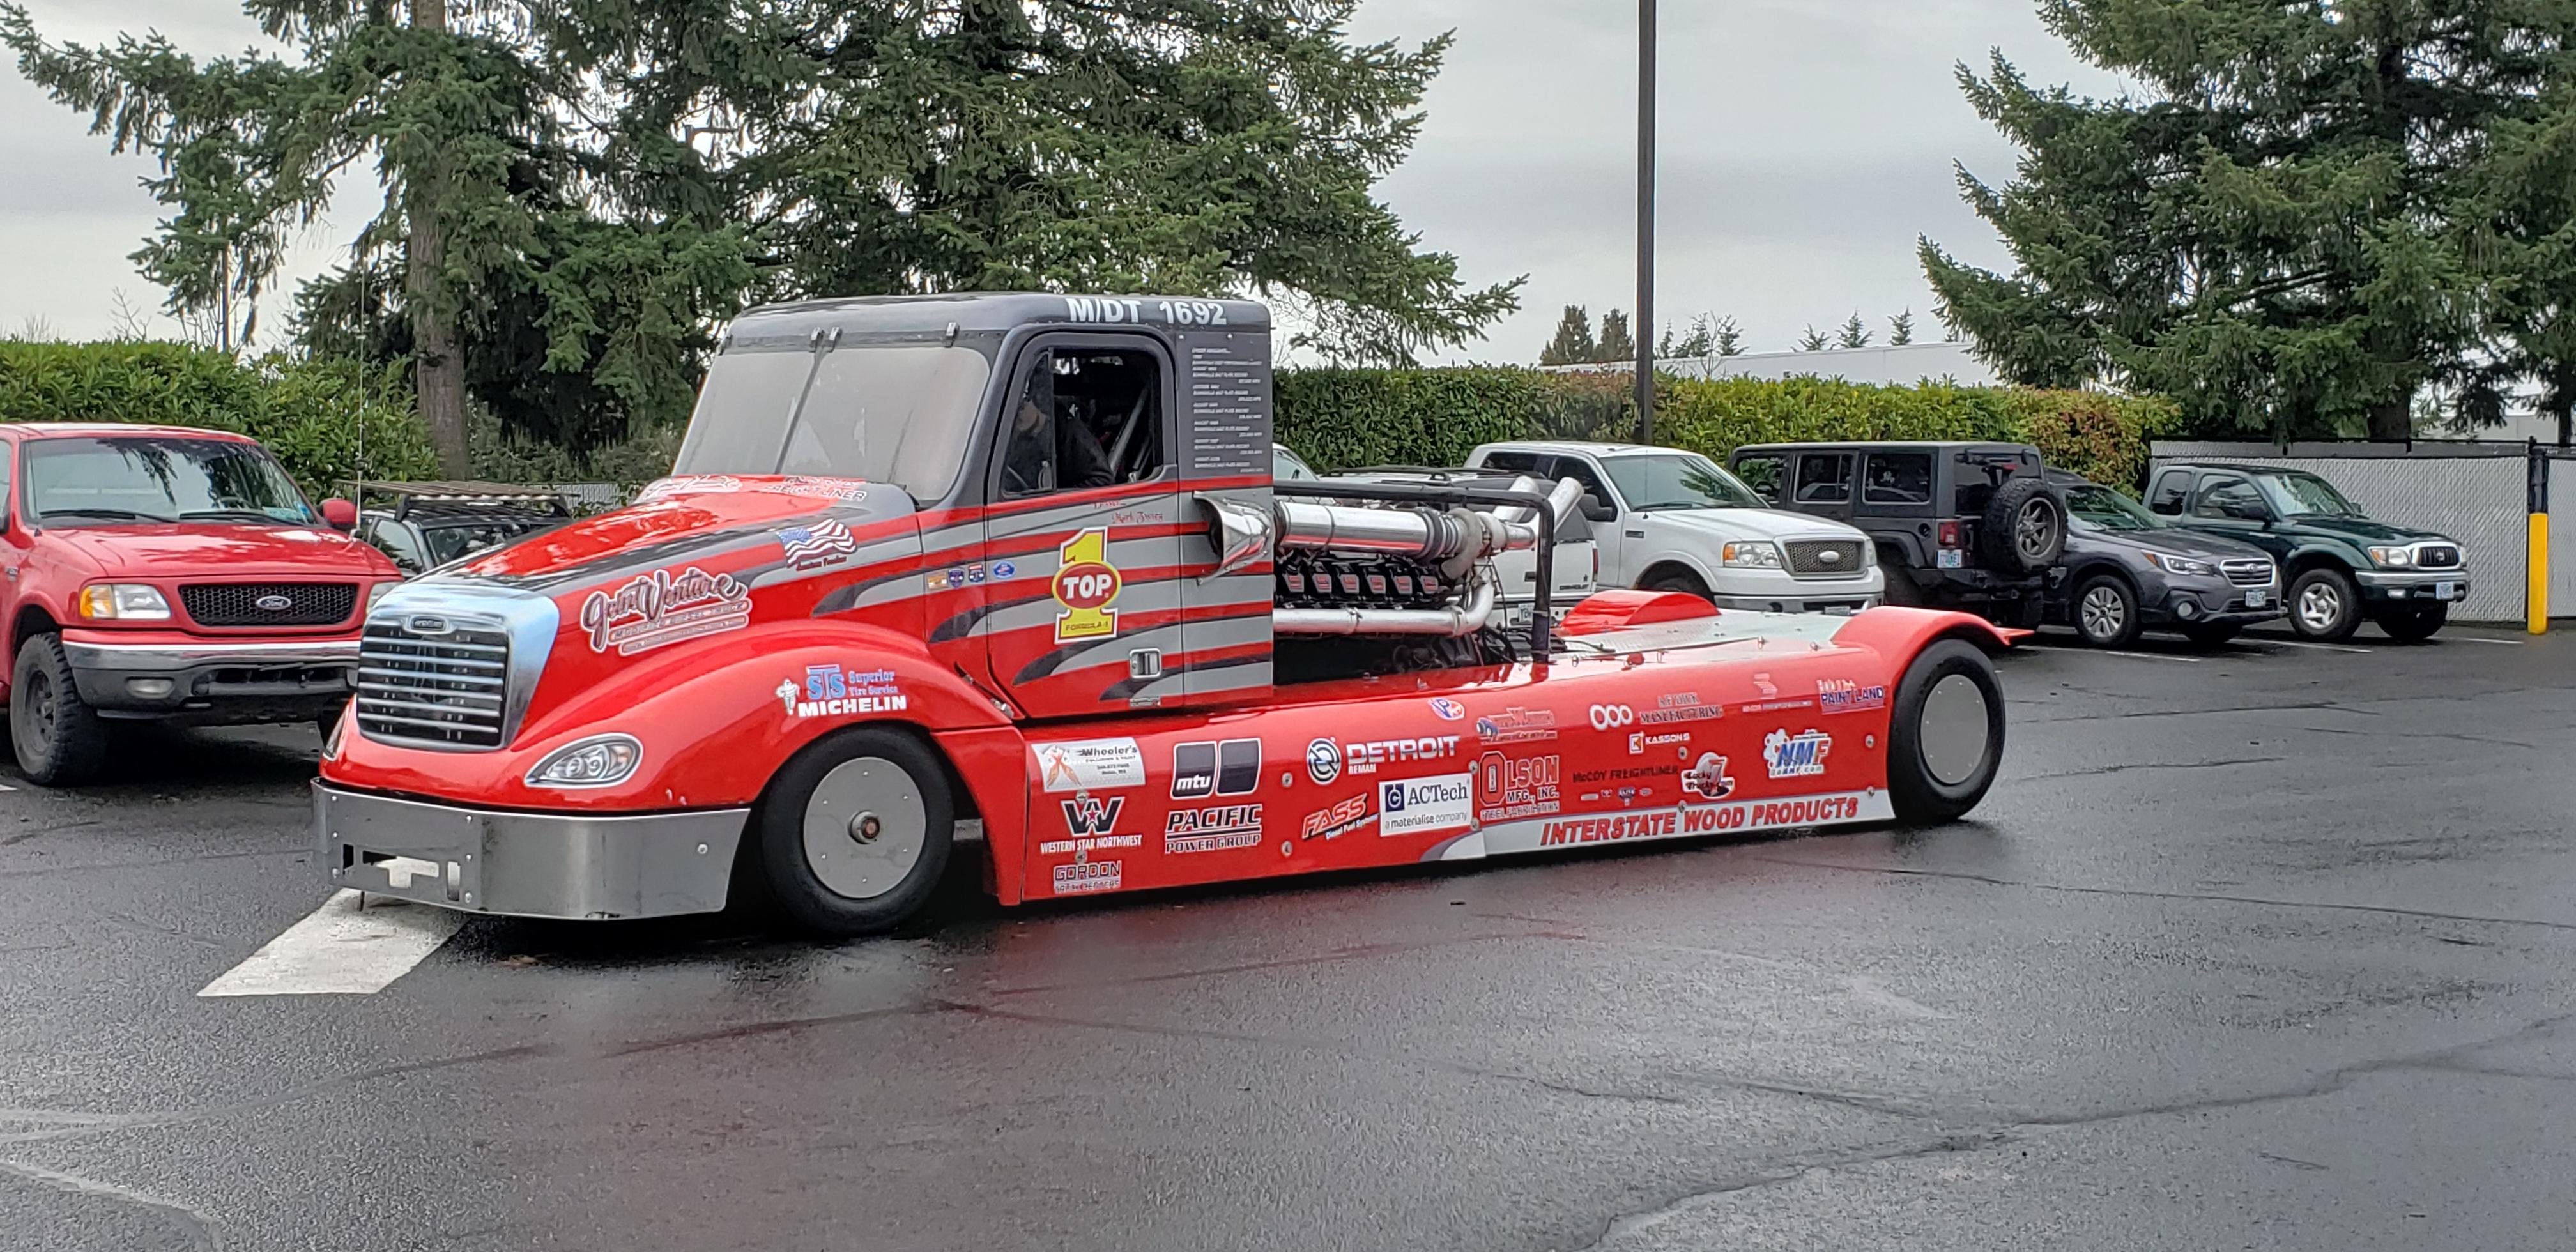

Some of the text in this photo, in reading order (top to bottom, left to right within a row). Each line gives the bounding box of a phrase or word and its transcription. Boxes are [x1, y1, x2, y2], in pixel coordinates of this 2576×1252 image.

[1065, 298, 1227, 325] M/DT 1692
[1062, 574, 1112, 600] TOP
[806, 664, 846, 700] STS
[848, 669, 894, 684] Superior
[798, 695, 907, 717] MICHELIN
[1346, 735, 1461, 764] DETROIT
[1777, 738, 1831, 768] NMF
[1348, 764, 1377, 775] REMAN
[1479, 751, 1560, 807] OLSON
[1176, 774, 1211, 790] mtu
[1407, 782, 1468, 805] ACTech
[1537, 785, 1560, 800] INC.
[1165, 804, 1263, 832] PACIFIC
[1302, 793, 1368, 839] FASS
[1385, 811, 1468, 829] a materialise company
[1540, 797, 1859, 846] INTERSTATE WOOD PRODUCTS
[1040, 834, 1143, 855] WESTERN STAR NORTHWEST
[1165, 834, 1262, 855] POWER GROUP
[1054, 860, 1123, 882] GORDON
